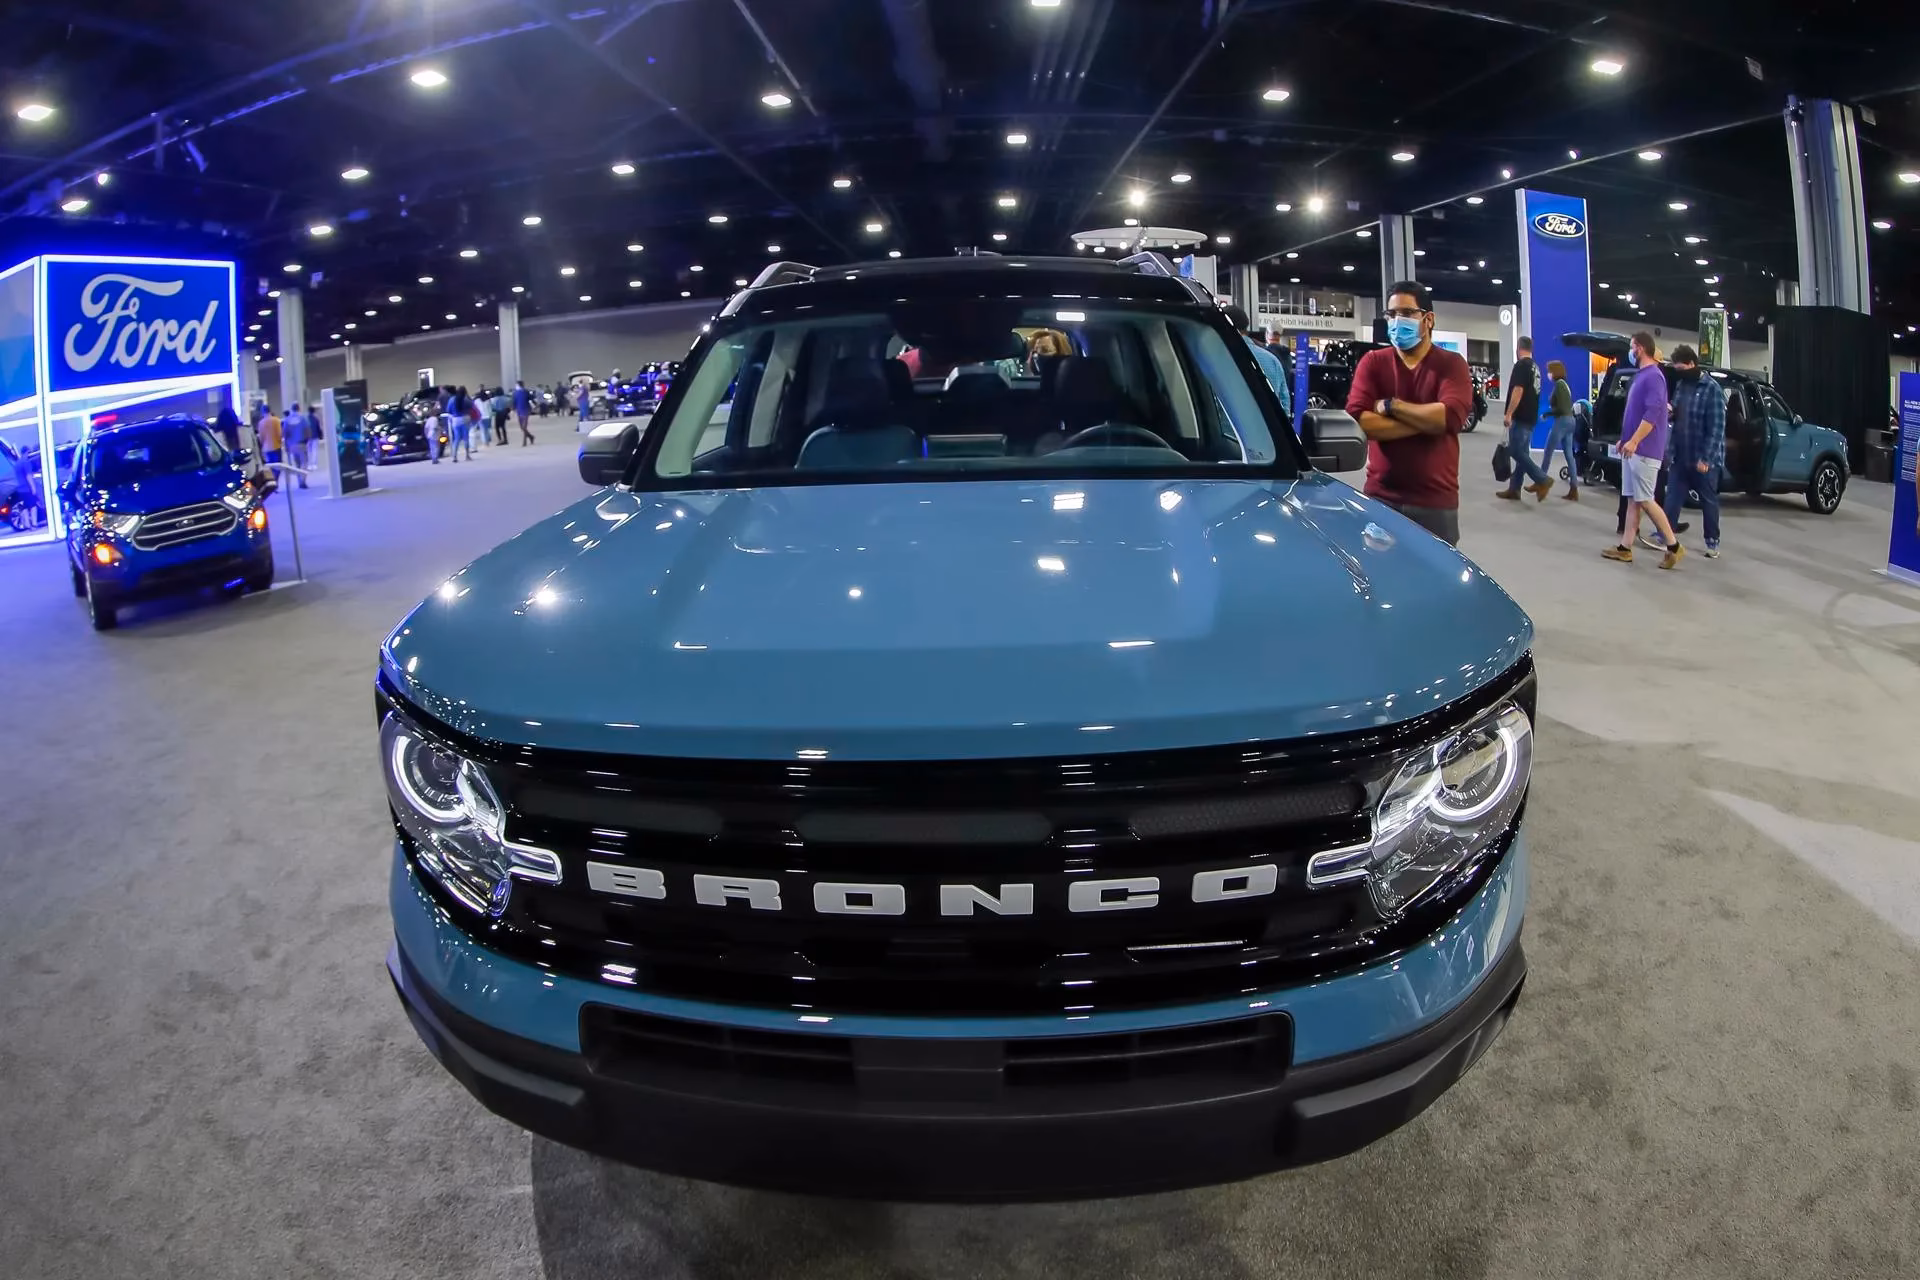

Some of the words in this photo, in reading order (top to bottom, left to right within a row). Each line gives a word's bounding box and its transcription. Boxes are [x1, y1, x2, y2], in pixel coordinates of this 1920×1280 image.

[1545, 215, 1576, 234] Ford
[64, 273, 219, 372] Ford
[1703, 316, 1719, 326] Jeep
[586, 861, 1278, 916] BRONCO
